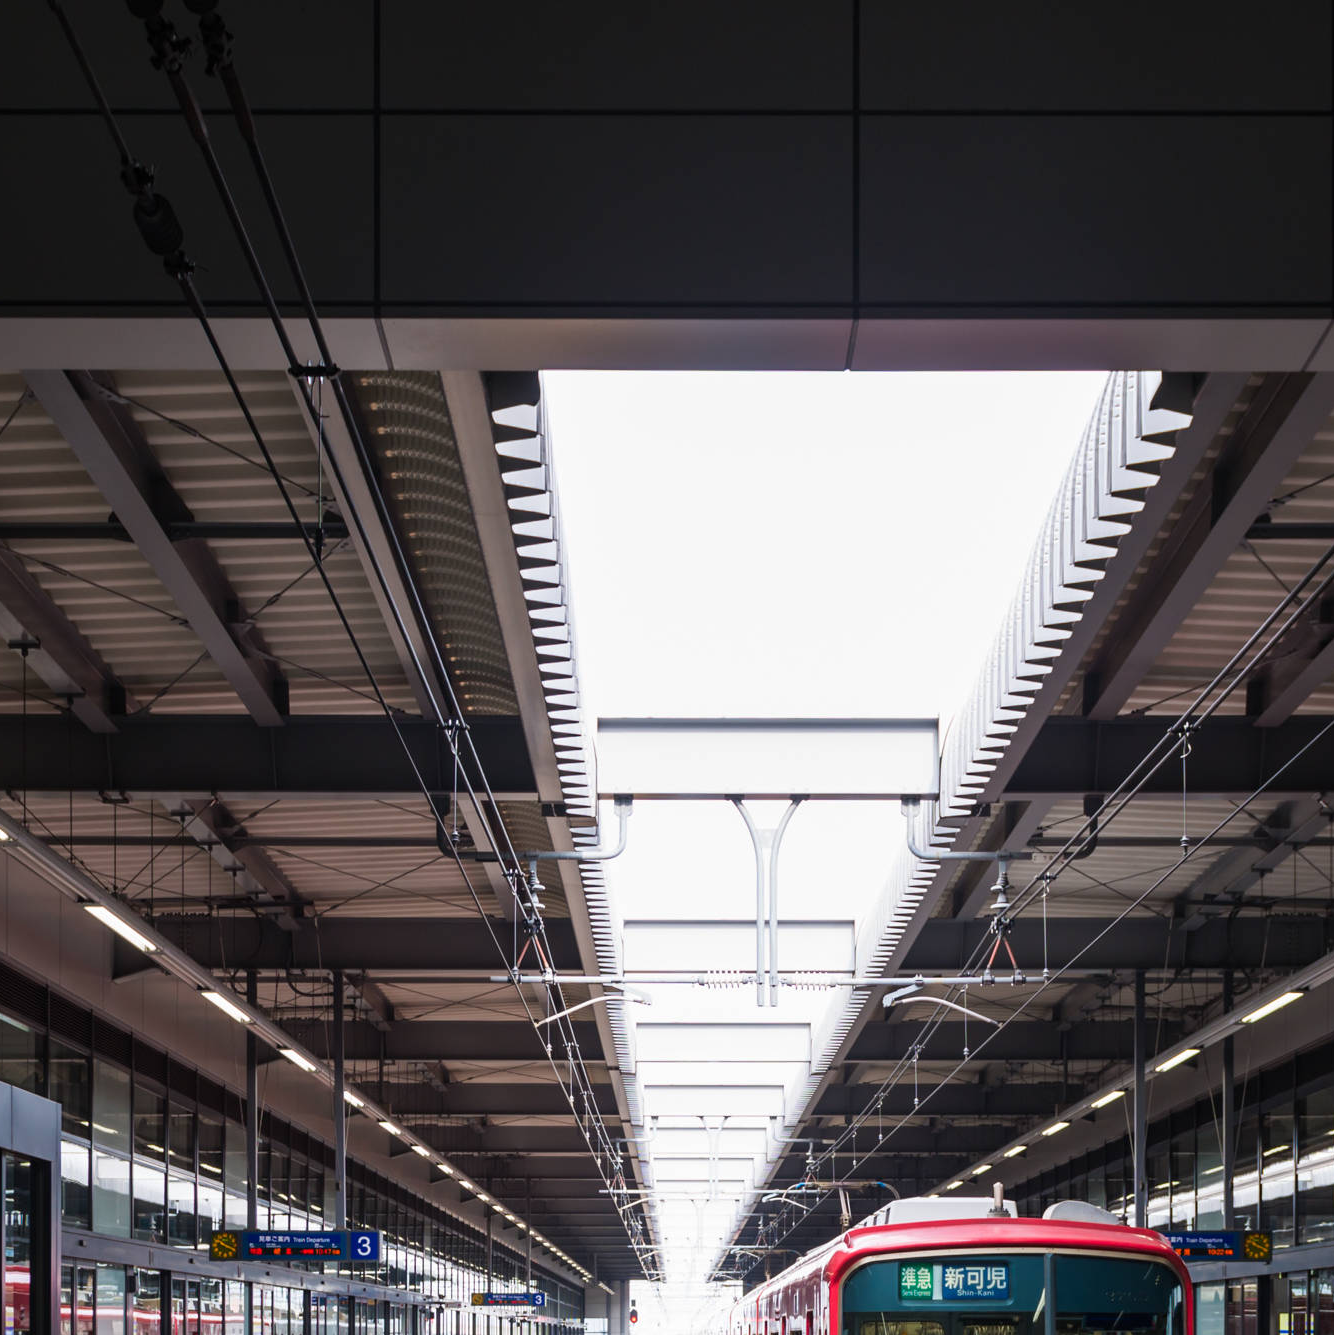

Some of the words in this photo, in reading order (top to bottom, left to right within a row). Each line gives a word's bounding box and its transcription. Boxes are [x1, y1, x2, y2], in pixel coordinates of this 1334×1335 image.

[307, 1236, 330, 1244] Departure
[357, 1236, 371, 1256] 3
[901, 1267, 931, 1289] 準急
[945, 1267, 1007, 1289] 新可児
[535, 1295, 542, 1304] 3
